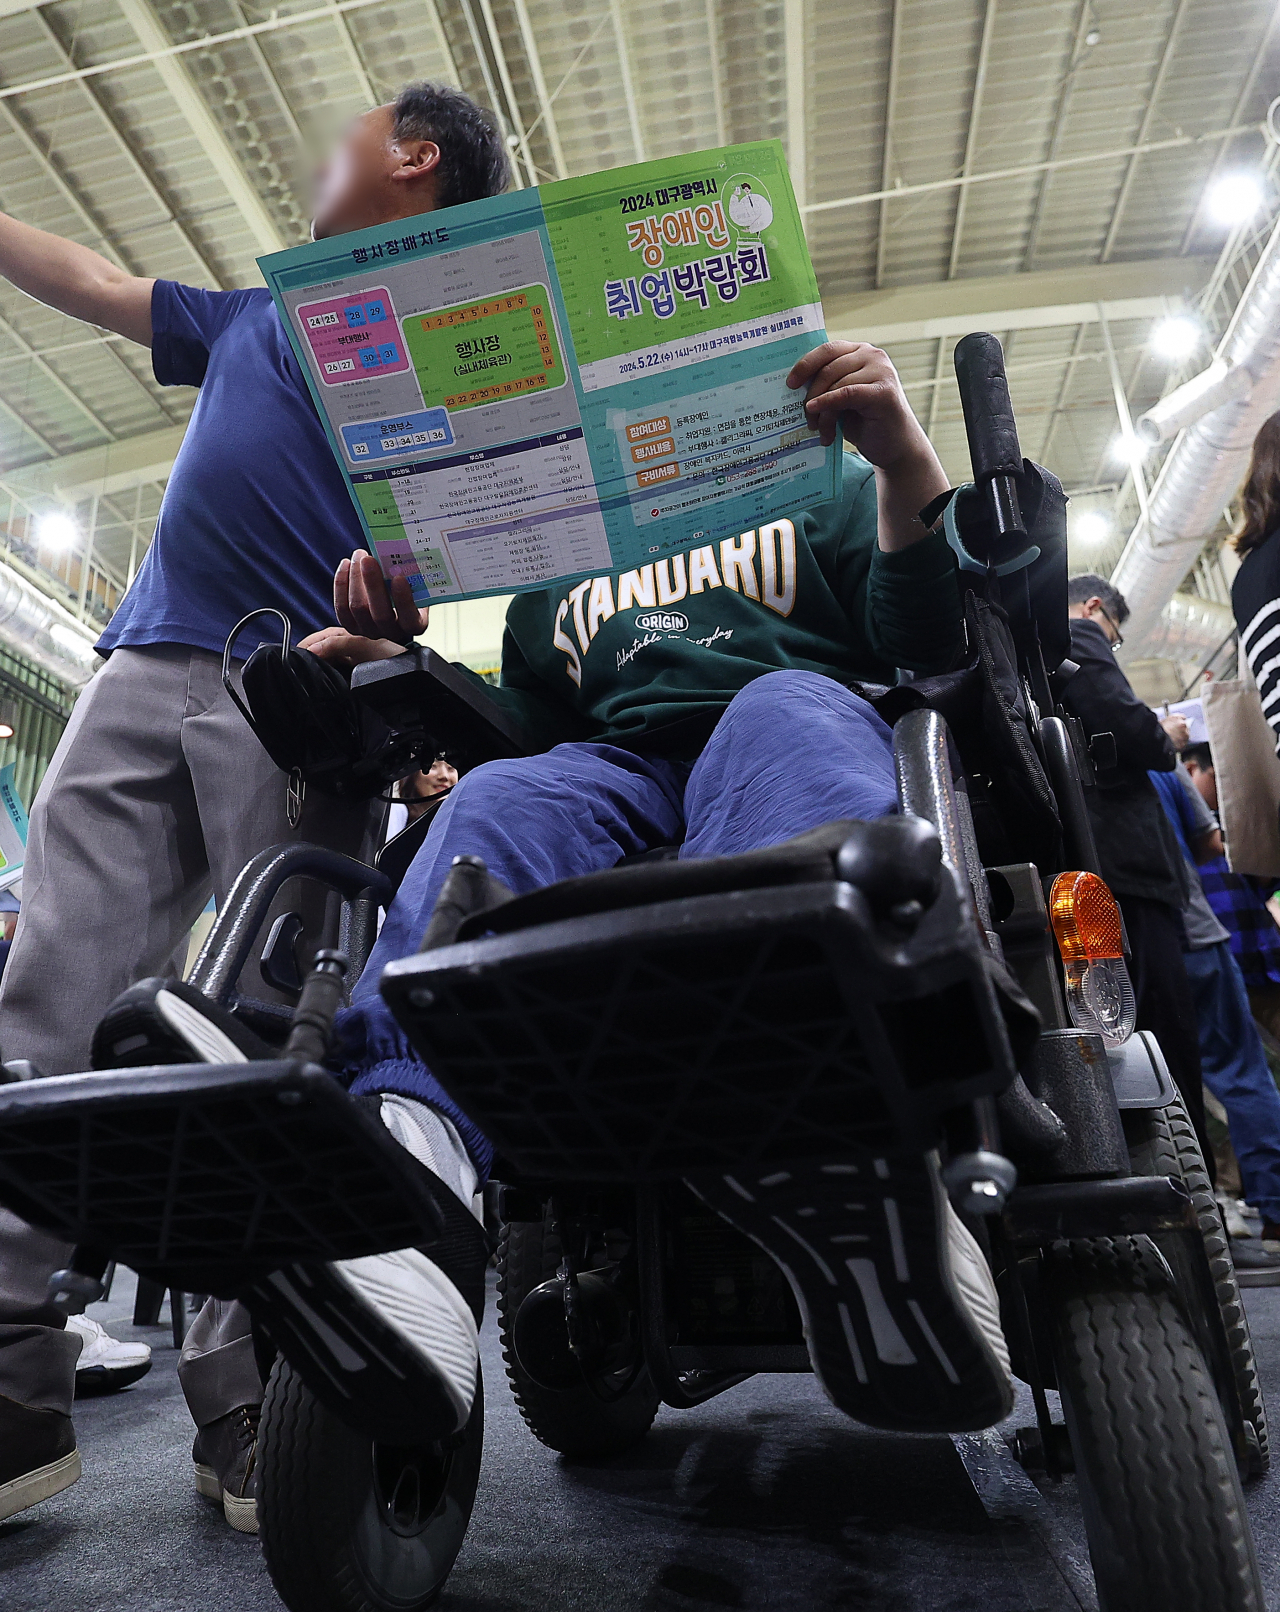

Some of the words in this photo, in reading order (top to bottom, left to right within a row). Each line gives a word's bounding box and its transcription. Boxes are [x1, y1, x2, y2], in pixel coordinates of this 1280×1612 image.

[619, 192, 655, 214] 2024
[655, 178, 718, 205] 대구광역시
[352, 227, 450, 264] 행사장배치도
[626, 201, 730, 267] 장애인
[604, 243, 771, 320] 취업박람회
[310, 318, 320, 326] 24
[324, 314, 336, 324] 25
[349, 311, 360, 320] 28
[370, 307, 381, 316] 29
[471, 309, 478, 317] 5
[337, 331, 370, 345] 부대행사
[455, 334, 500, 359] 행사장
[539, 333, 547, 341] 12
[619, 351, 674, 374] 2024.5.22.(수)
[674, 342, 709, 359] 14시~17시
[769, 315, 804, 333] 실내체육관
[327, 363, 338, 372] 26
[341, 361, 351, 369] 27
[363, 354, 374, 362] 30
[384, 349, 394, 358] 31
[453, 353, 512, 376] (실내체육관)
[458, 395, 467, 403] 22
[479, 390, 489, 398] 20
[492, 387, 500, 395] 19
[503, 384, 512, 392] 18
[526, 379, 535, 387] 16
[537, 376, 545, 384] 15
[380, 421, 414, 435] 운영부스
[629, 419, 667, 438] 참여대상
[676, 411, 709, 427] 등록장애인
[685, 426, 711, 440] 취업지원
[355, 445, 366, 453] 32
[384, 439, 395, 448] 33
[400, 437, 412, 445] 34
[415, 434, 426, 442] 35
[433, 431, 444, 439] 36
[634, 441, 671, 459] 행사내용
[640, 464, 676, 482] 구비서류
[683, 458, 703, 471] 장애인
[553, 517, 798, 689] STANDARD
[641, 614, 684, 629] ORIGIN
[616, 632, 662, 672] Adaptable
